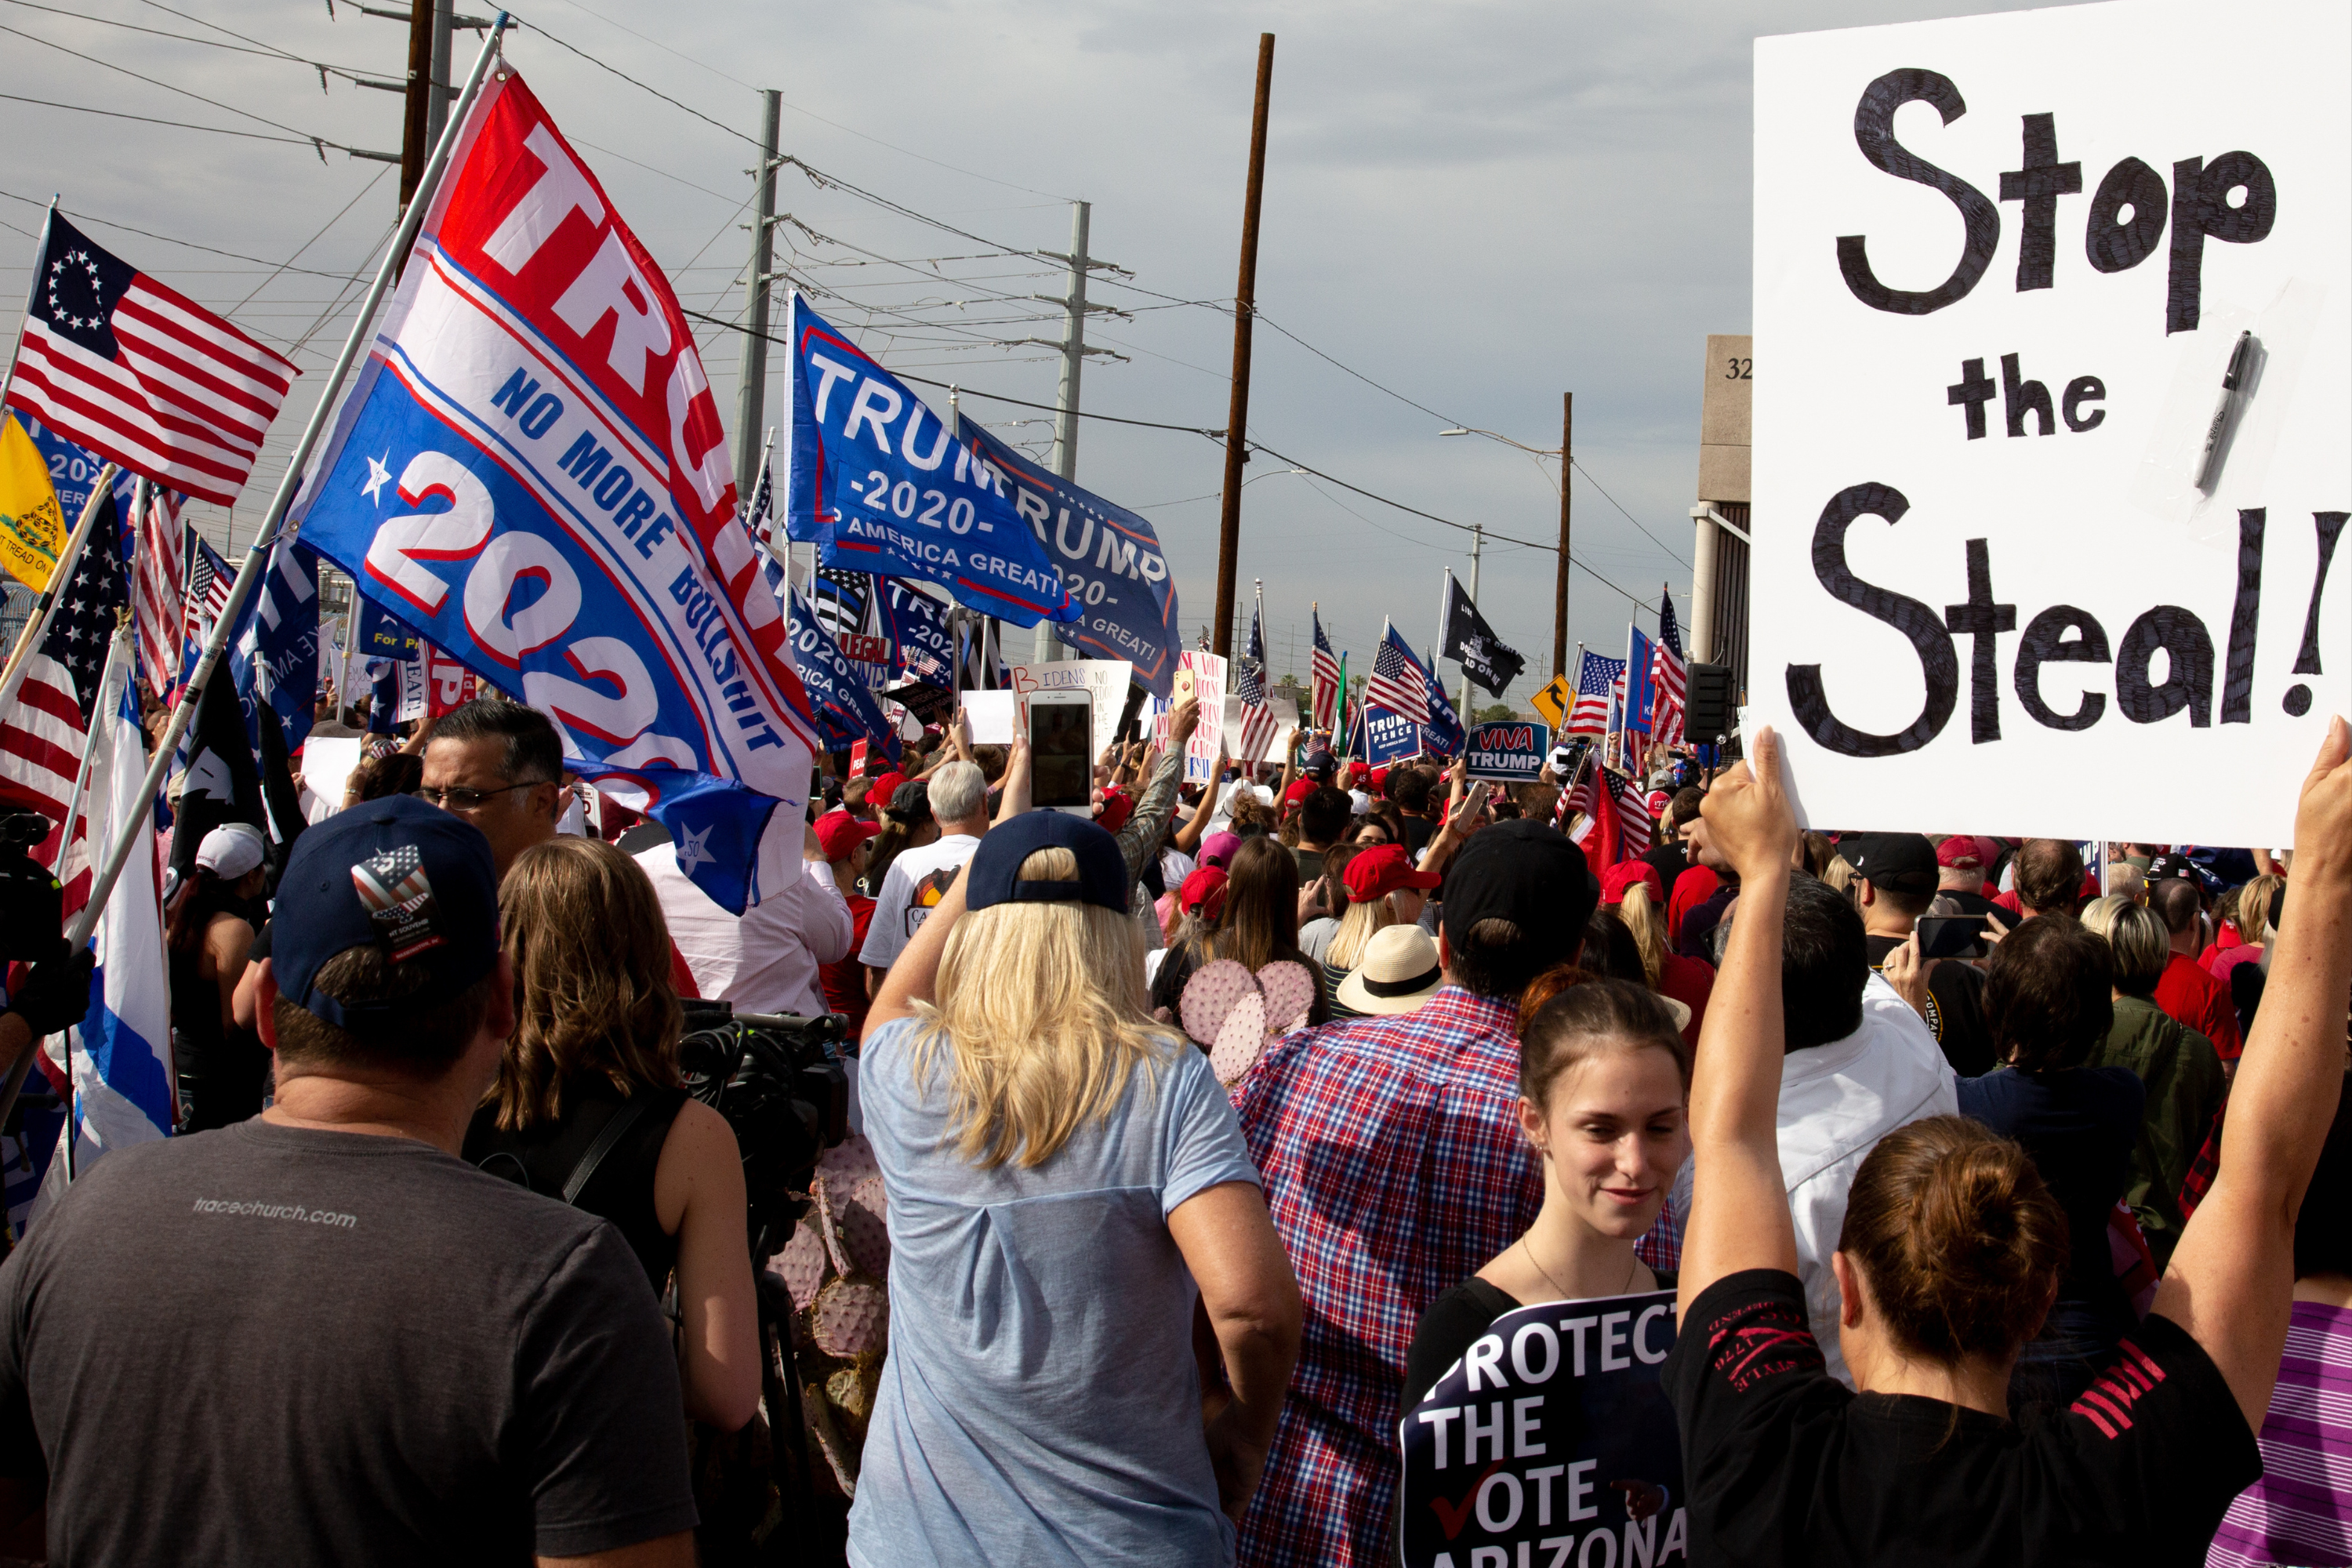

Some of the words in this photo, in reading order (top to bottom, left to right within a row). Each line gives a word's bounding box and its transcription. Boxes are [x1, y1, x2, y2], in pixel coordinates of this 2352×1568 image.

[1836, 67, 2277, 336] Stop
[1947, 352, 2107, 441] the
[851, 470, 994, 535] -2020-
[982, 458, 1167, 587] TRUMP
[7, 539, 34, 565] TREAD
[35, 560, 49, 573] ON
[490, 366, 564, 441] NO
[557, 429, 676, 561] MORE
[668, 563, 786, 752] BULLSHIT
[848, 517, 960, 567] AMERICA
[969, 554, 1058, 598] GREAT!
[1784, 481, 2350, 757] Steal!
[374, 632, 397, 645] For
[840, 632, 890, 665] LEGAL
[1092, 618, 1156, 661] GREAT!
[1368, 714, 1411, 735] TRUM
[1374, 725, 1412, 744] PENCE
[1479, 725, 1534, 751] VIVA
[1468, 751, 1541, 770] TRUMP
[1357, 774, 1367, 782] 45
[193, 1196, 358, 1229] tracechurch.com
[1714, 1337, 1755, 1371] 1776
[1418, 1395, 1547, 1470] THE
